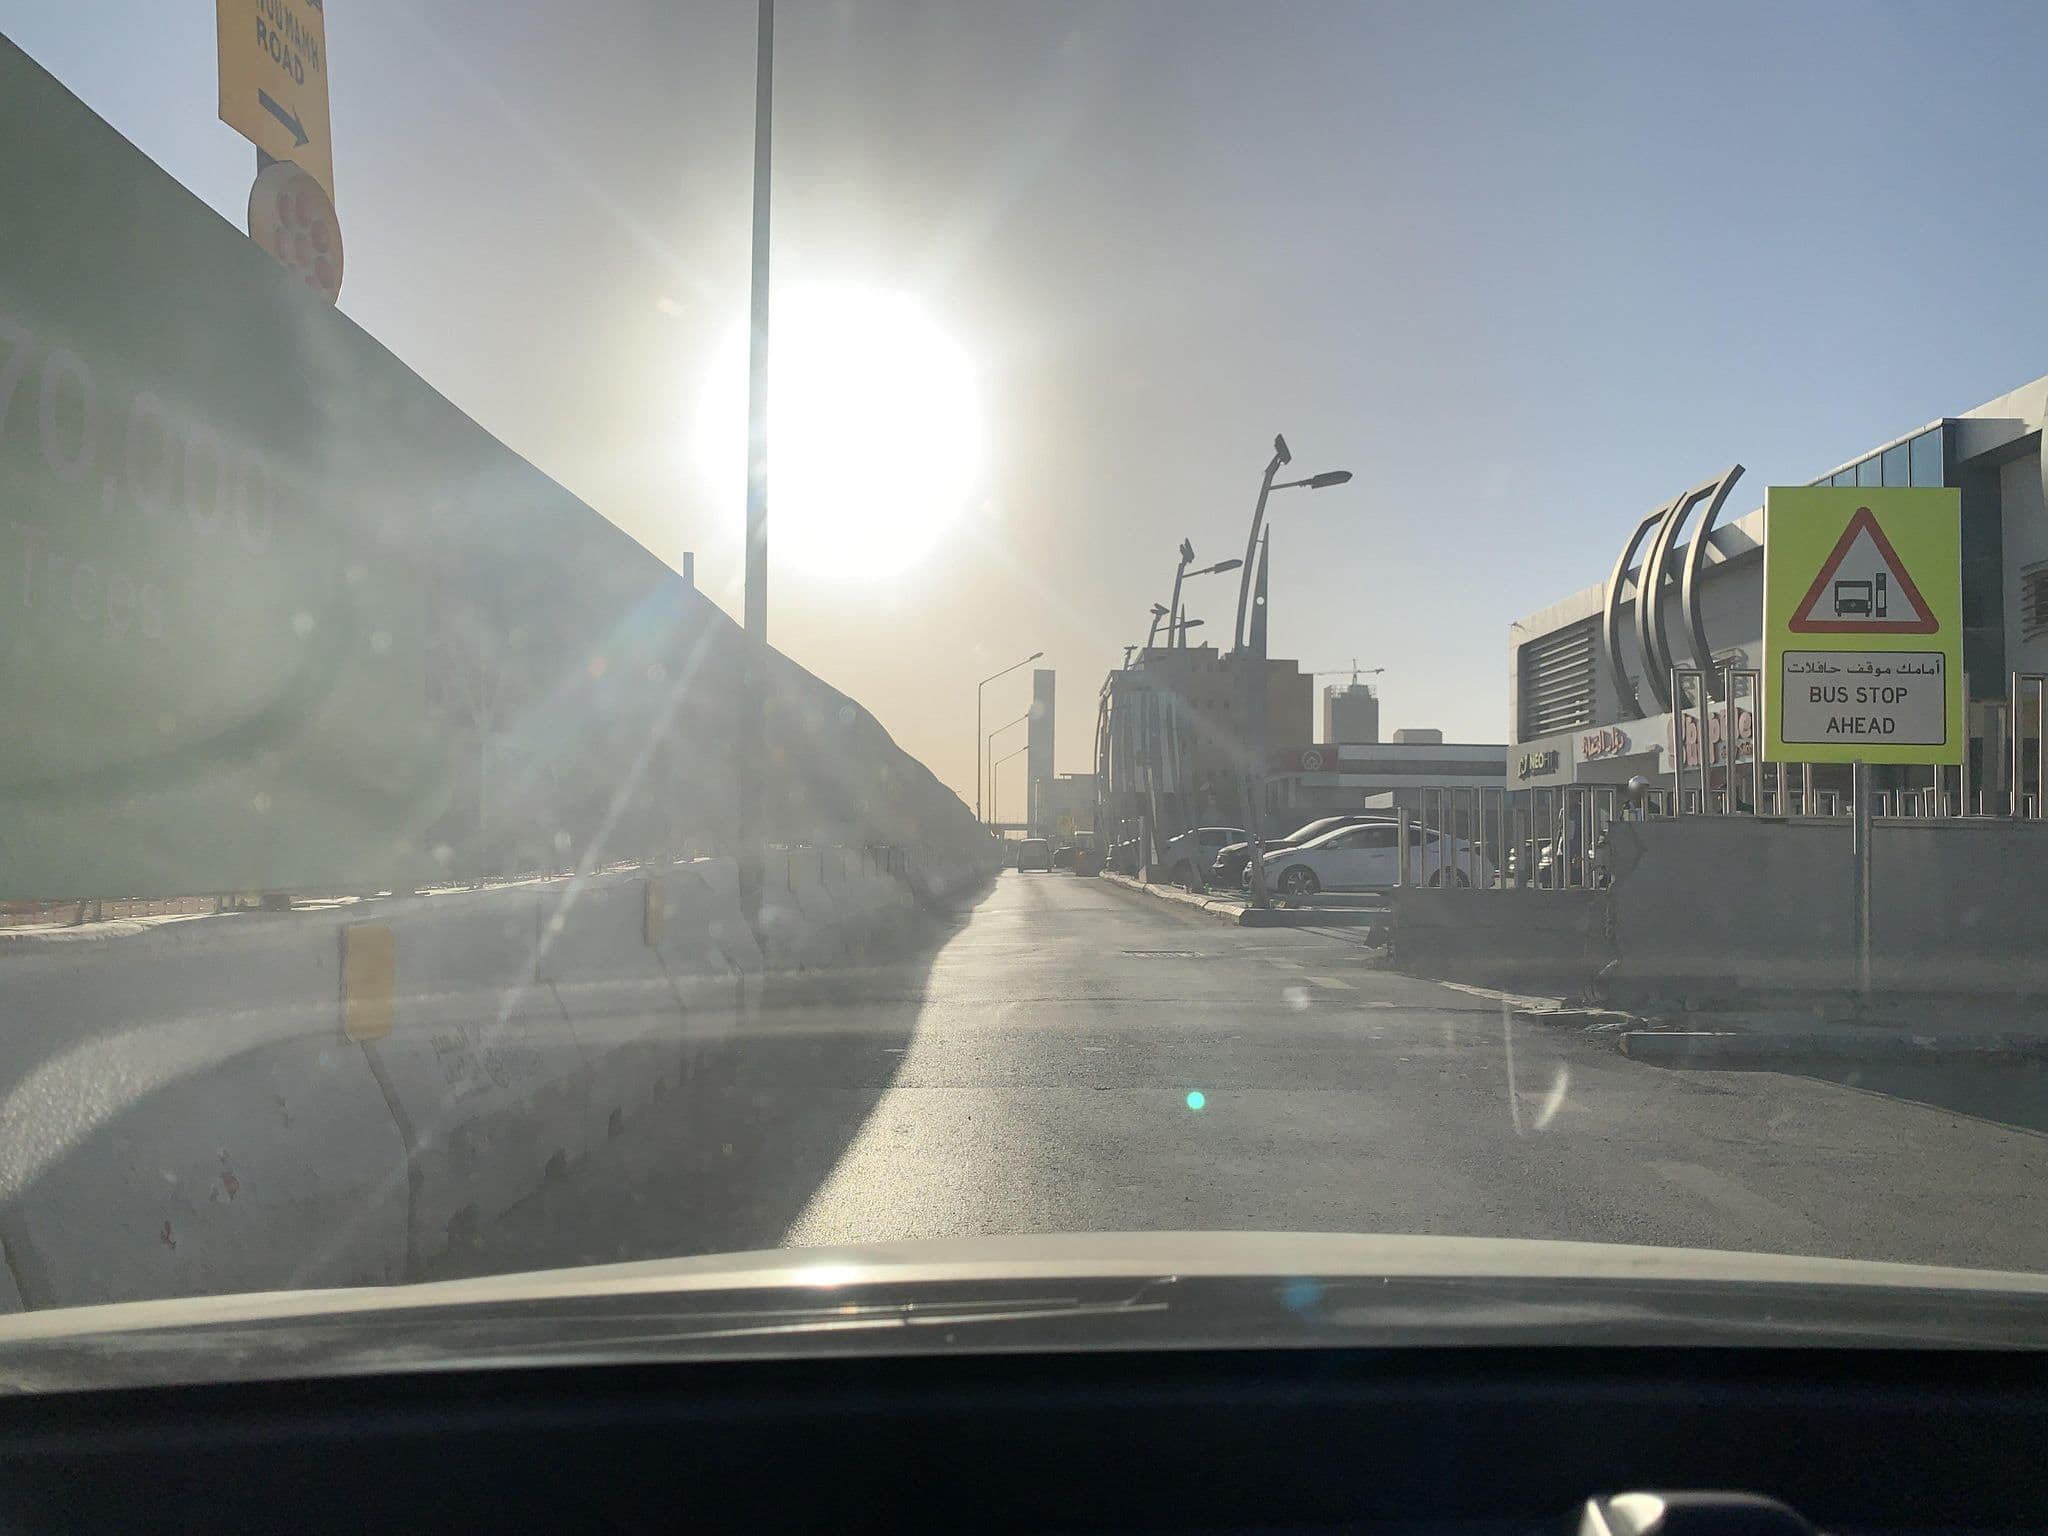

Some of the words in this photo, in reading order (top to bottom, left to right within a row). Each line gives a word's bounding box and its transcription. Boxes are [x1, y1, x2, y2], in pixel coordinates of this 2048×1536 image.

[256, 16, 304, 85] ROAD
[1787, 661, 1841, 675] حافلات
[1847, 660, 1891, 677] موقف
[1895, 659, 1941, 676] أمامك
[1809, 686, 1849, 703] BUS
[1856, 687, 1908, 704] STOP
[1826, 717, 1896, 734] AHEAD
